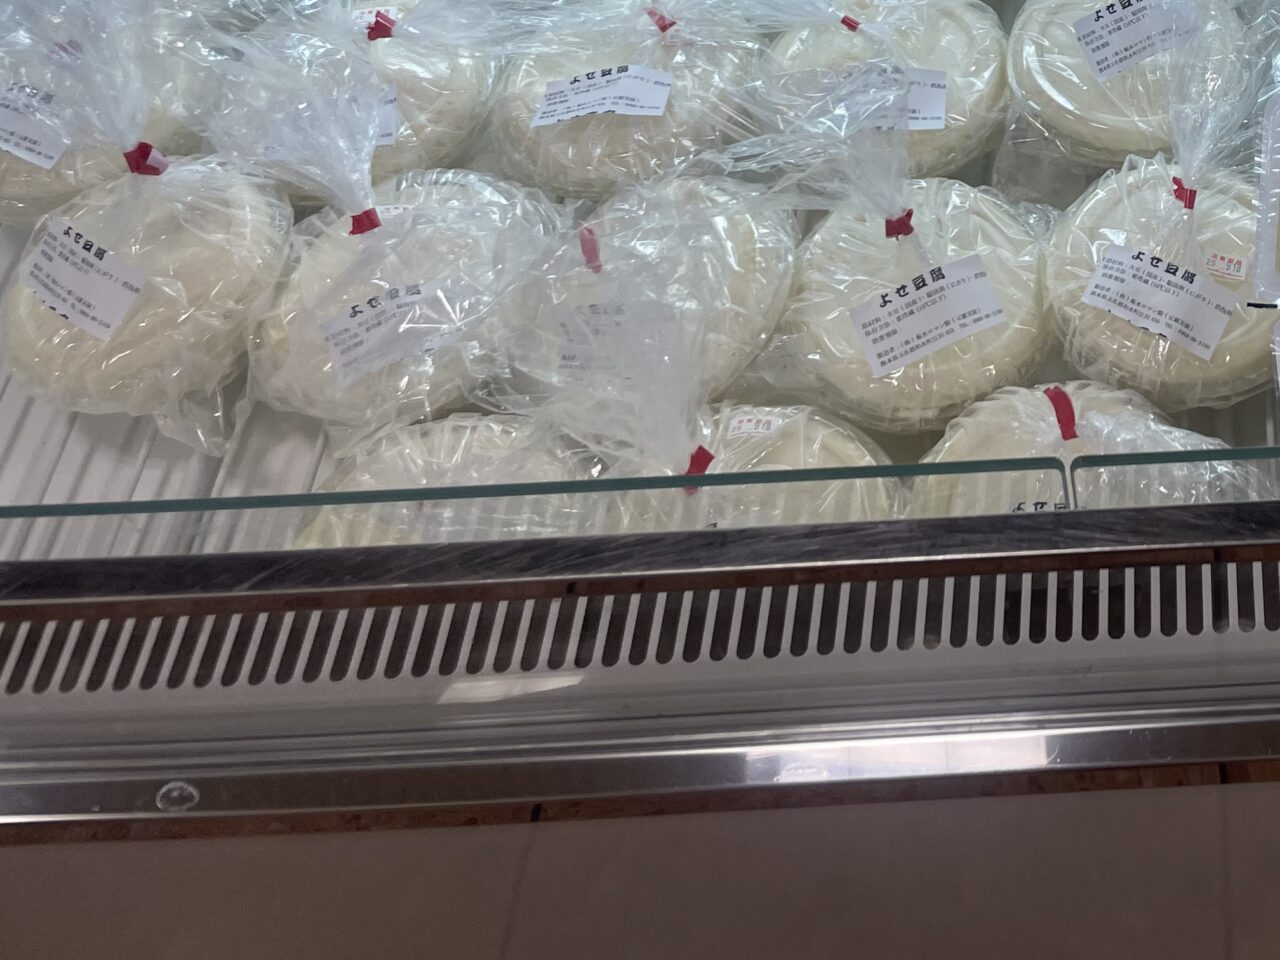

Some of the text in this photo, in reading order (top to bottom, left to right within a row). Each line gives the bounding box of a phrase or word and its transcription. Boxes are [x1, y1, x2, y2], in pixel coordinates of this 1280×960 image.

[570, 65, 629, 85] よせ豆腐
[63, 226, 107, 261] よせ豆腐
[1131, 251, 1197, 284] よせ豆腐
[879, 266, 945, 308] よせ豆腐
